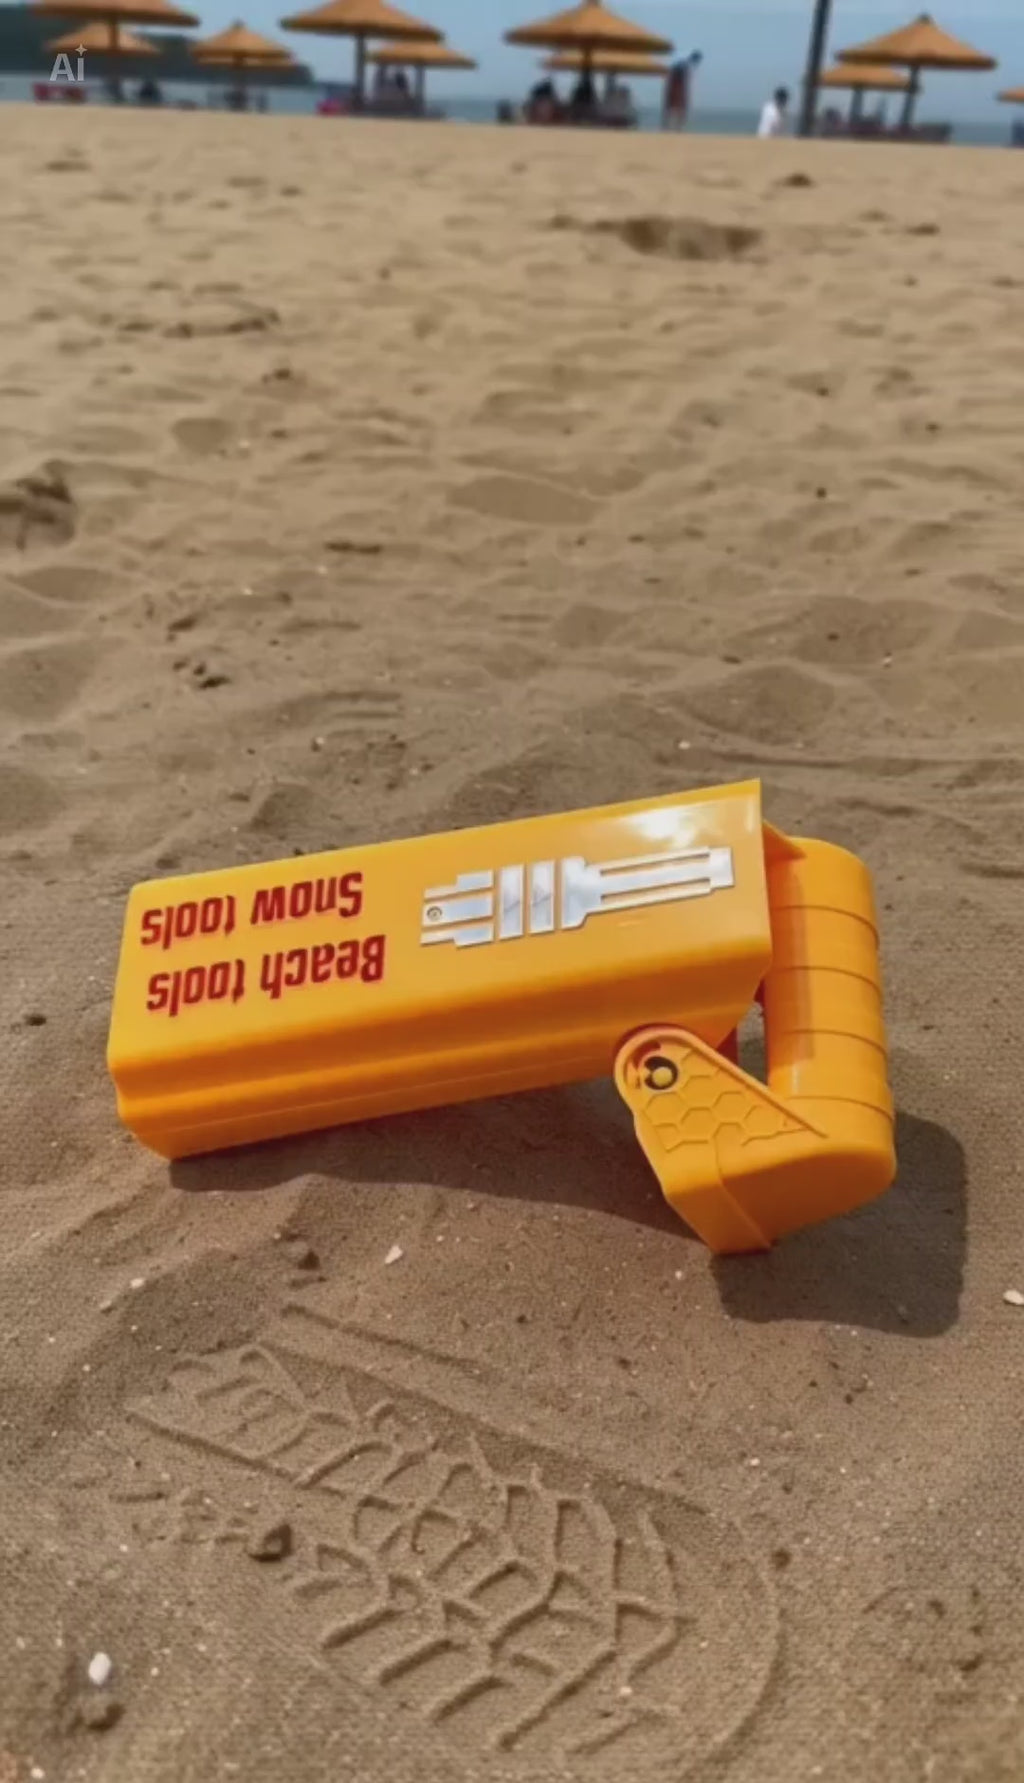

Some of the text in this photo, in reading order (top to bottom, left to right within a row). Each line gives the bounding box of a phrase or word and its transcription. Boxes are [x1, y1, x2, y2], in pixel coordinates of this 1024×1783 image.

[140, 871, 363, 950] Snow tools
[146, 934, 386, 1018] Beach tools
